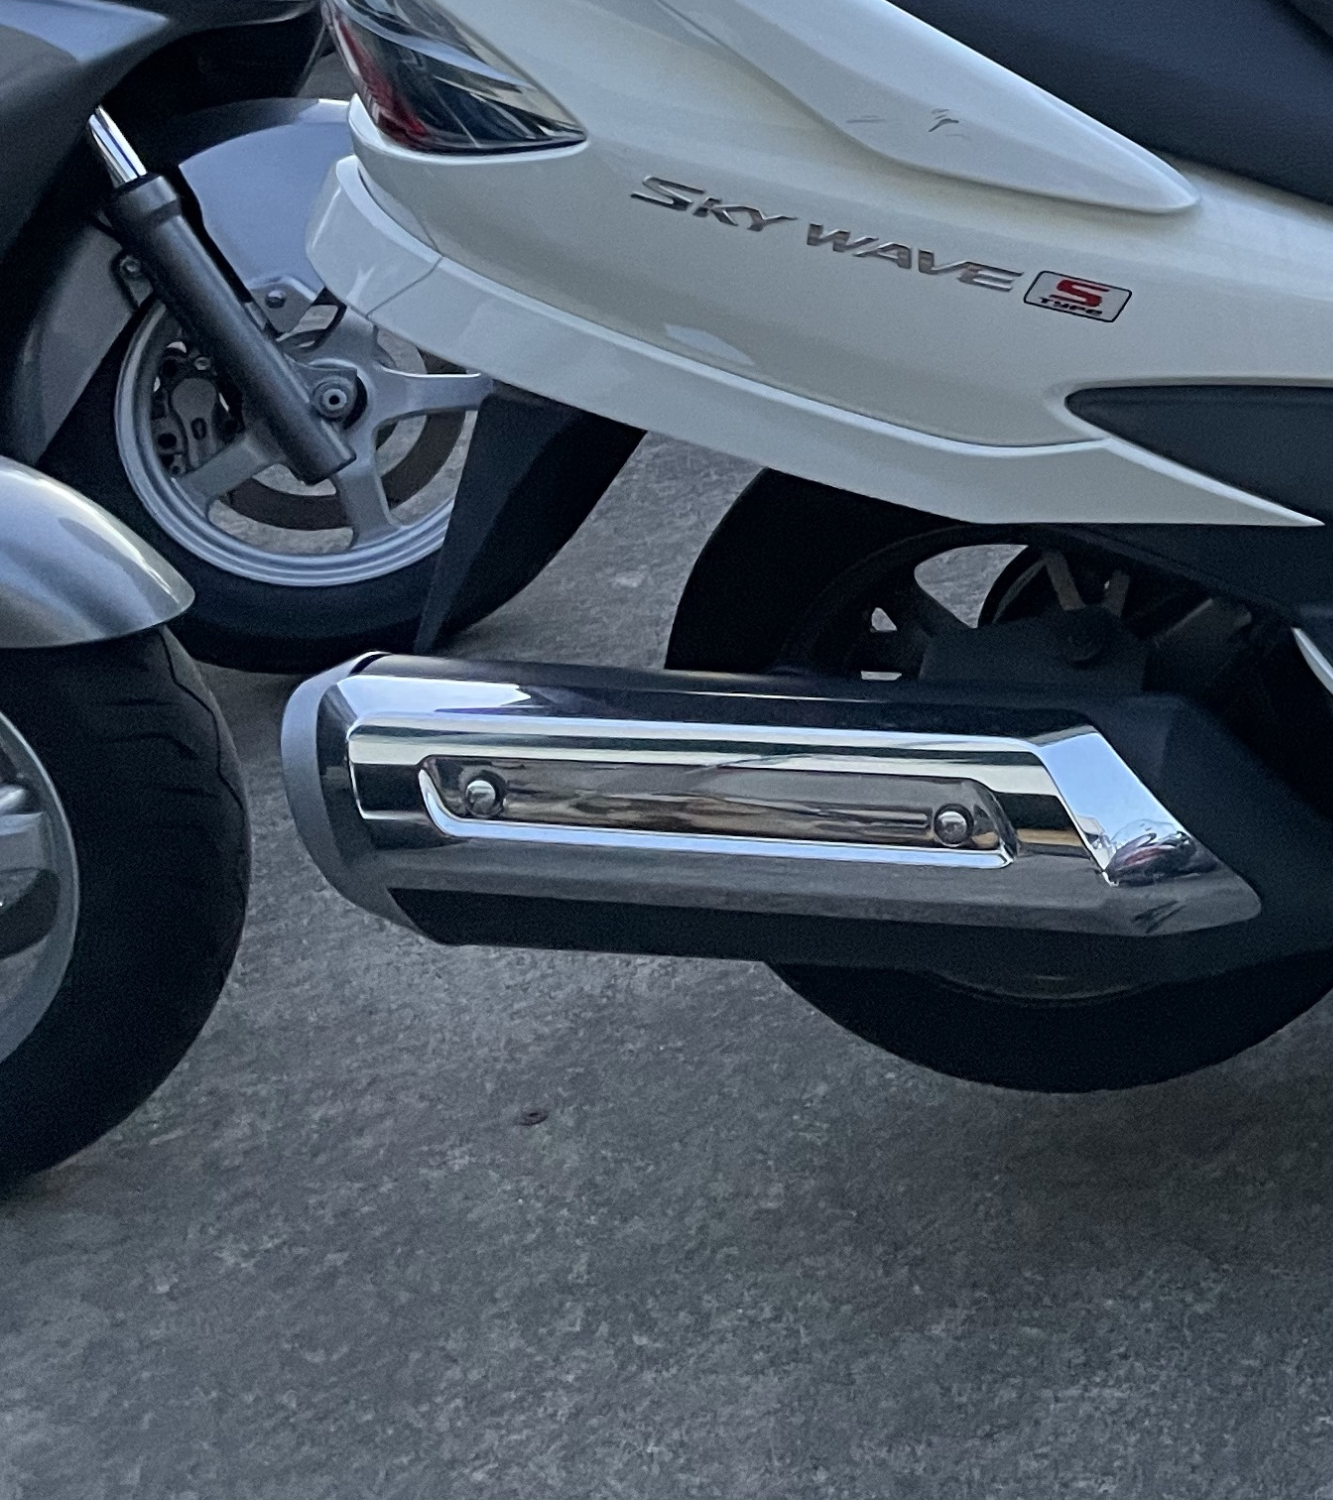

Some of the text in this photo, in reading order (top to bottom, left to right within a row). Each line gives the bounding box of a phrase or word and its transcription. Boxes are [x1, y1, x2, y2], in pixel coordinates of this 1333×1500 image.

[629, 175, 1110, 308] SKY WAVE S
